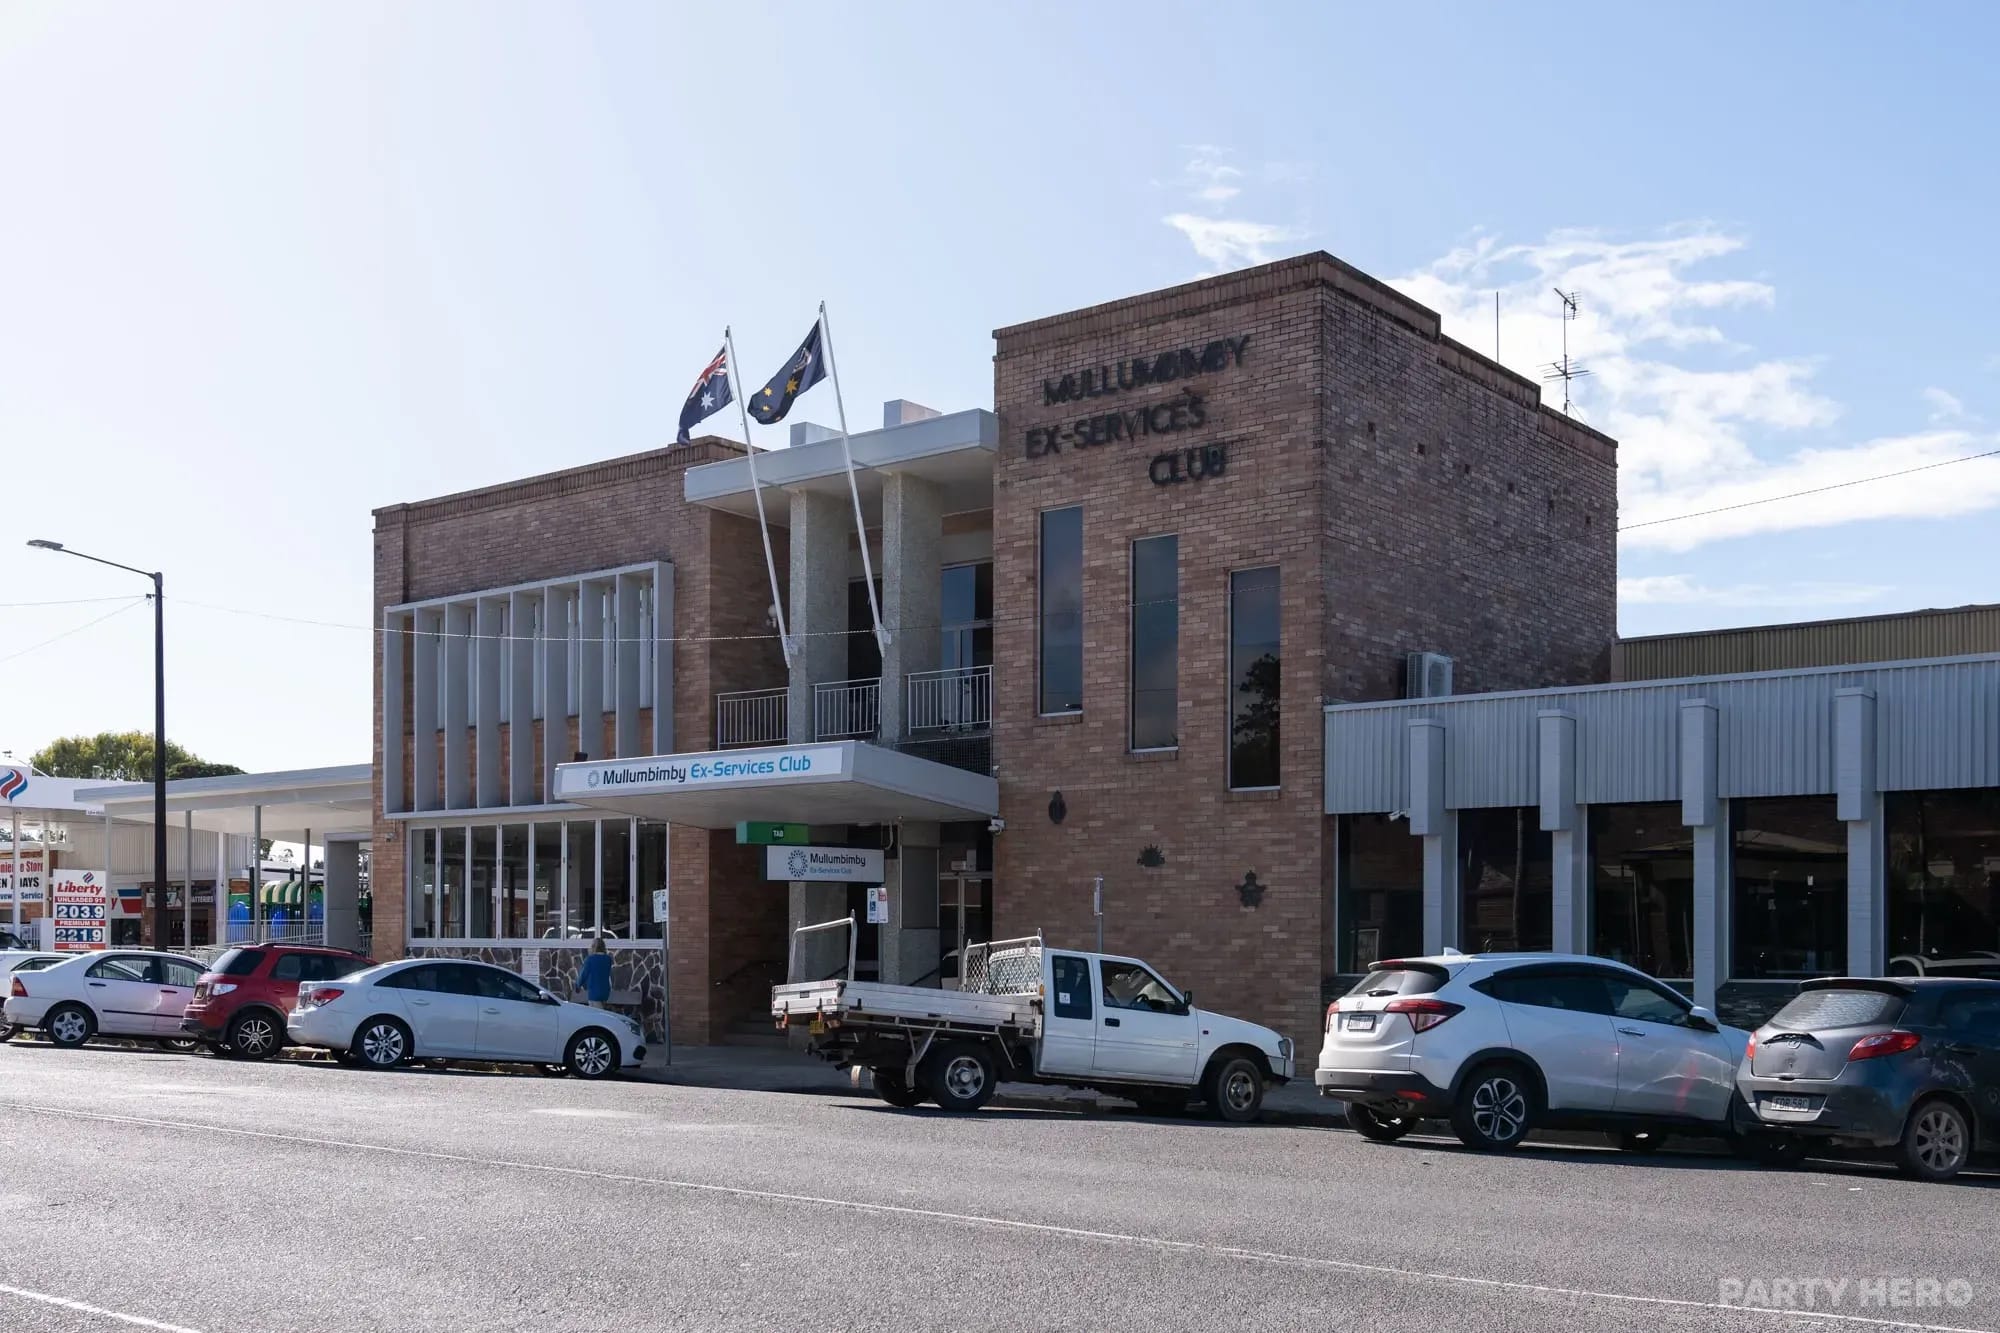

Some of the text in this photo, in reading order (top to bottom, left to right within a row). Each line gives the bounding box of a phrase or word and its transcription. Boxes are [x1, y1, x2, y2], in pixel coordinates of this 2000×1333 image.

[1026, 395, 1207, 460] EX-SERVICES
[1149, 444, 1227, 485] CLUB
[603, 755, 812, 785] Mullumbimby Ex-Services Club
[809, 853, 867, 867] Mullumbimby
[57, 880, 104, 896] Liberty
[57, 896, 93, 904] UNLEADED
[58, 905, 105, 919] 203.9
